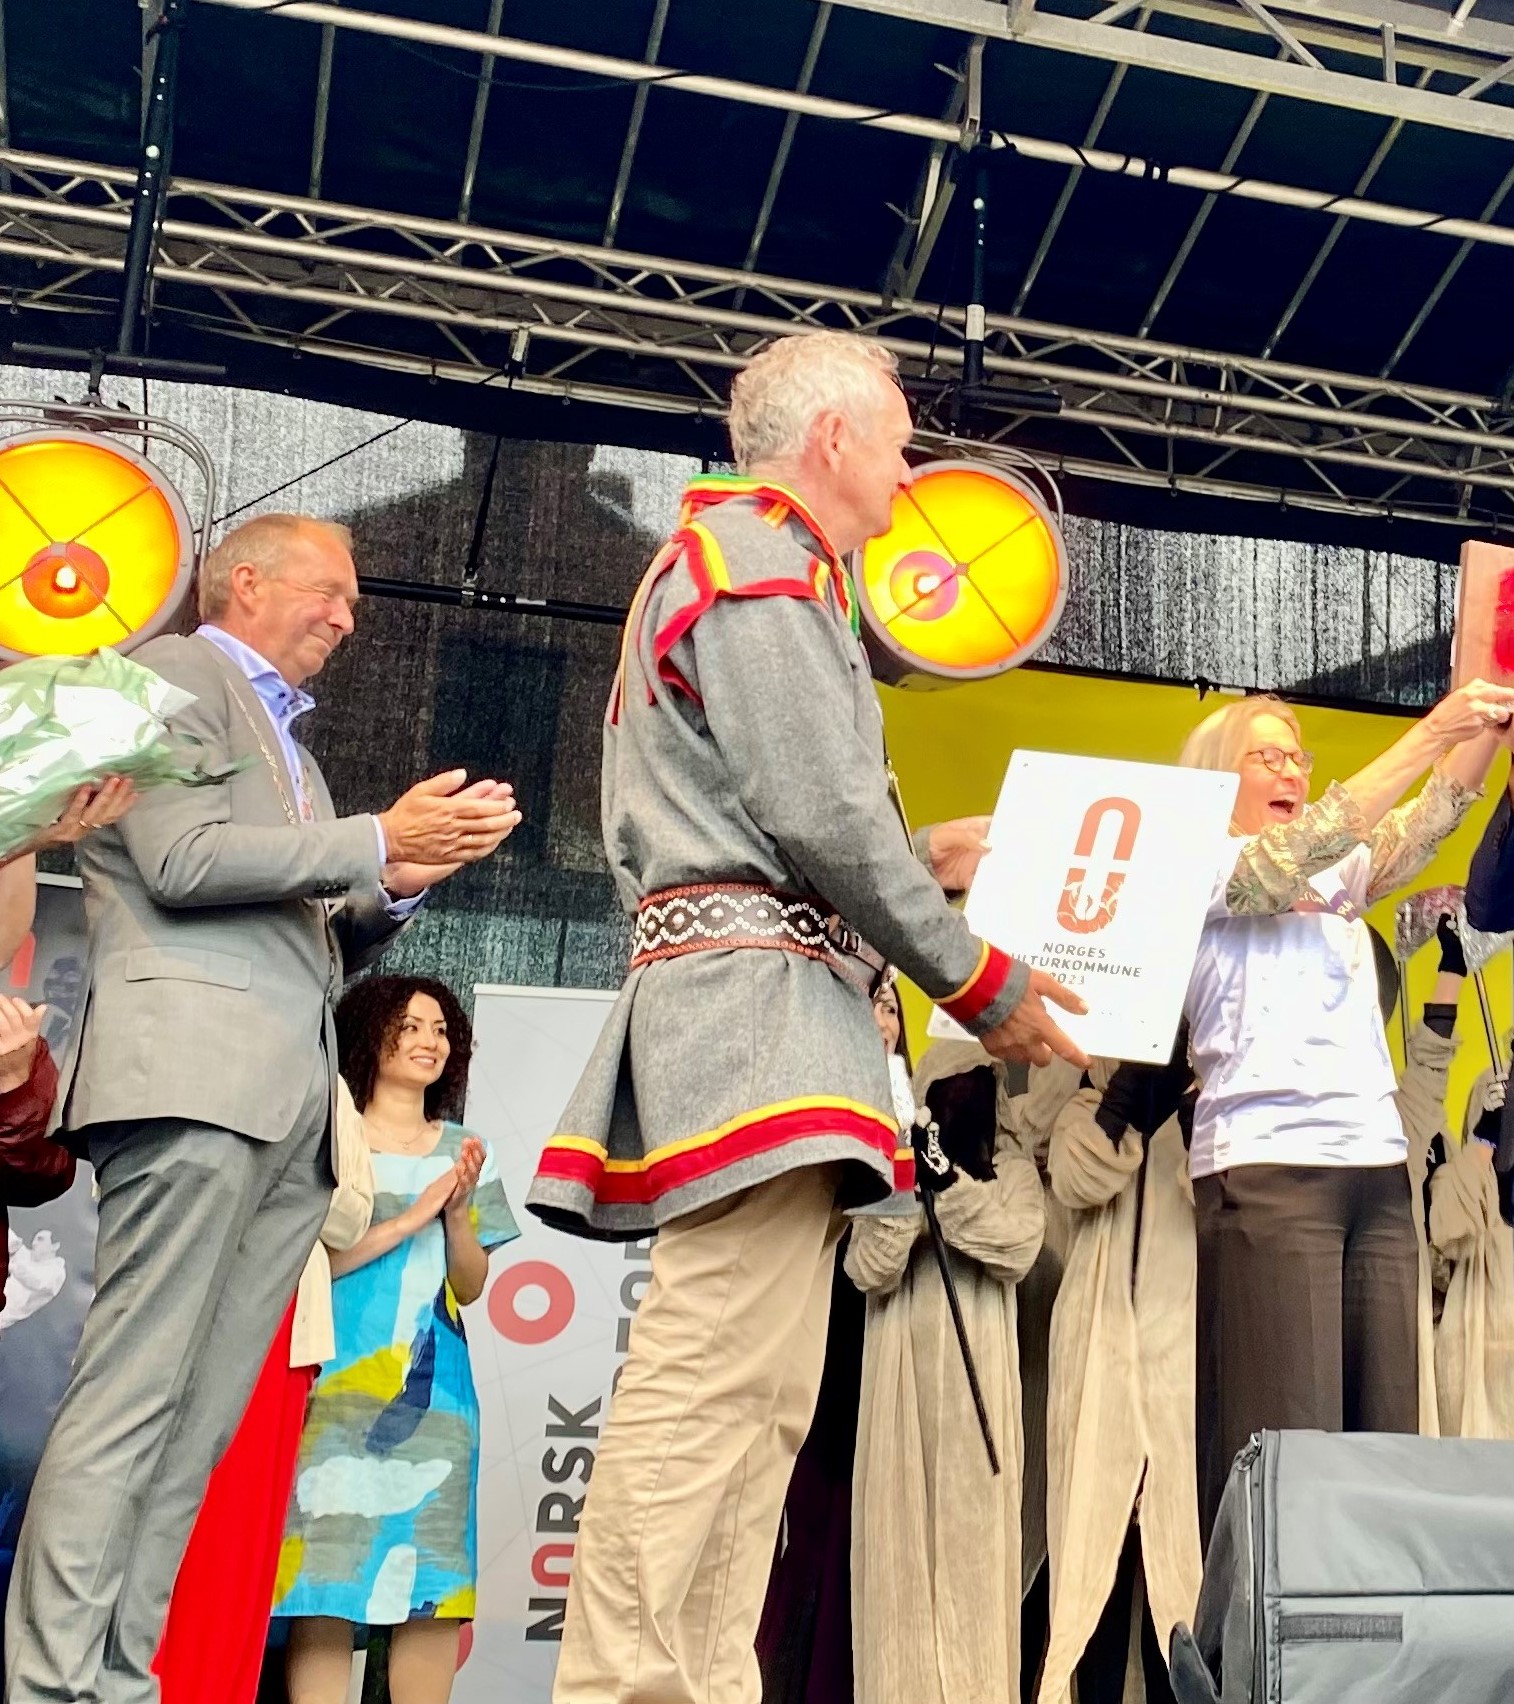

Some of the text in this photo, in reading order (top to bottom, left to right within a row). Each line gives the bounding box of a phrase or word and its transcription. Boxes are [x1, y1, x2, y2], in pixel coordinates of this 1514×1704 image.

[1042, 942, 1106, 959] NORGES
[1011, 952, 1142, 978] ULTURKOMMUNE
[525, 1393, 602, 1642] NORSK
